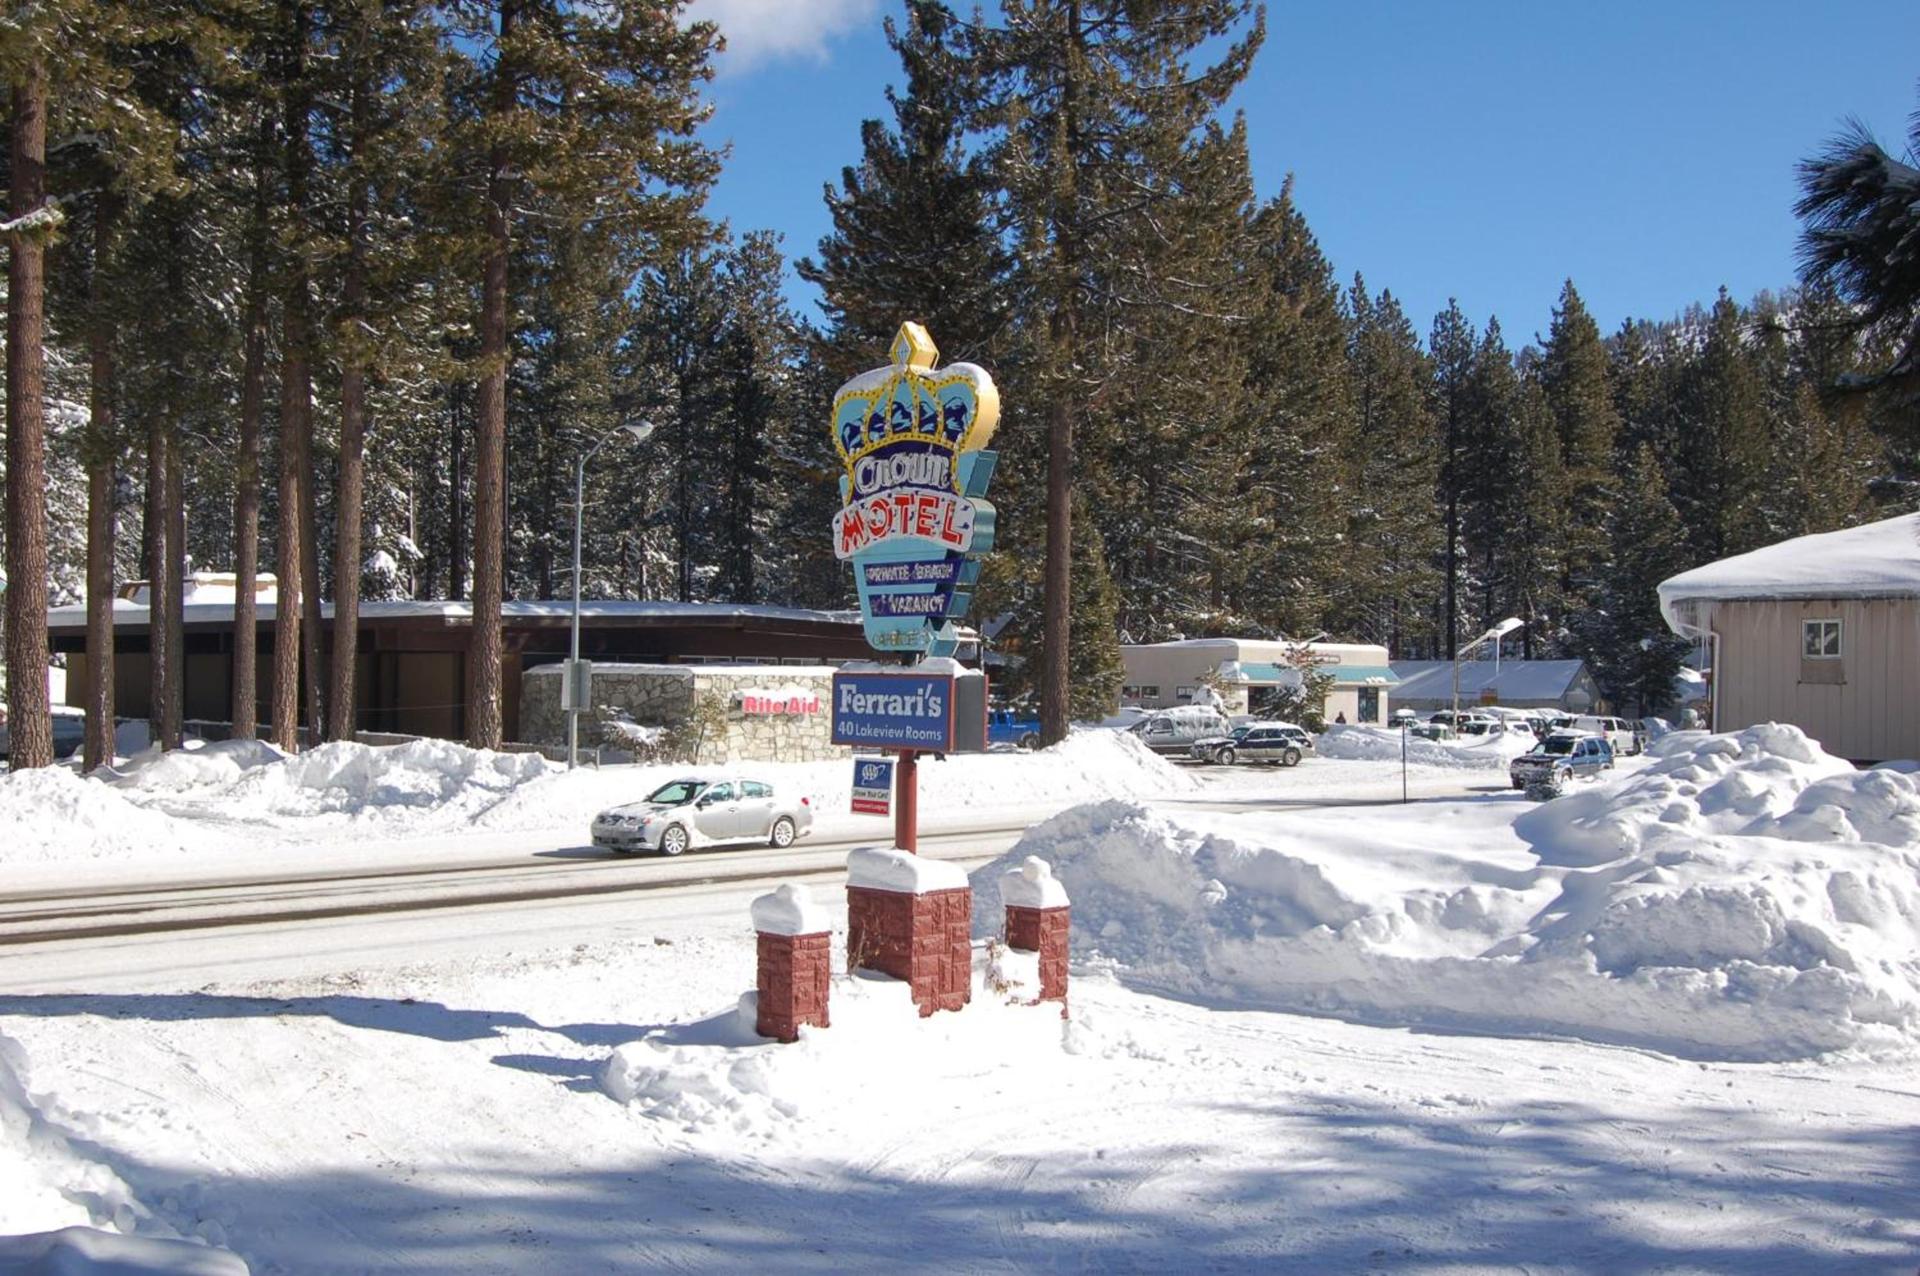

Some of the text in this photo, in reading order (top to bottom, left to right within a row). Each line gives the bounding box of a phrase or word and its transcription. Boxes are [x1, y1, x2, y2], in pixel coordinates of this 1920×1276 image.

[854, 452, 950, 495] Crown
[841, 493, 963, 552] MOTEL
[866, 564, 910, 582] PRIVATE
[890, 594, 946, 613] VACANCY
[743, 696, 819, 713] Rite Aid
[839, 683, 942, 718] Ferrari's
[838, 720, 942, 741] 40 Lakeview Rooms
